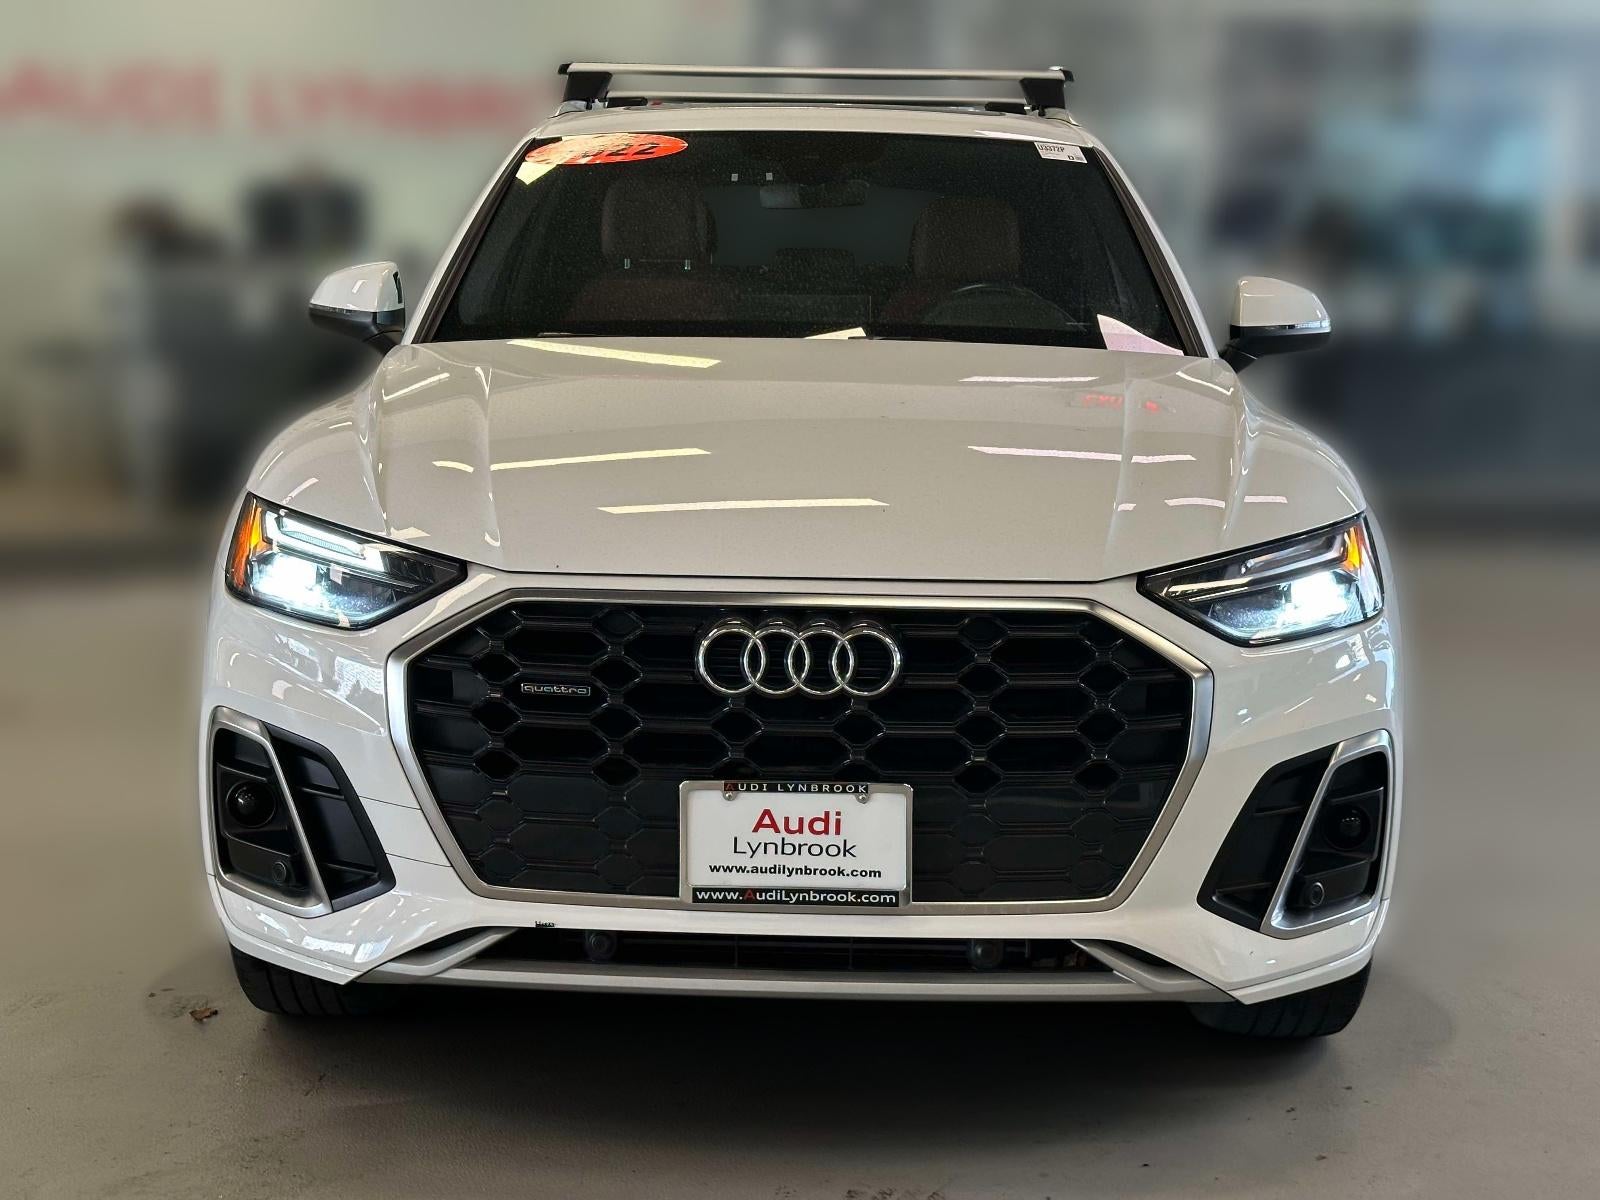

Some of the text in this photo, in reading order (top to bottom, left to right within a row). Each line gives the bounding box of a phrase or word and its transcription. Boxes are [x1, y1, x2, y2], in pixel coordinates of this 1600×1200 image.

[524, 685, 587, 694] quattro
[726, 783, 867, 793] AUDI LYNBROOK
[752, 808, 842, 836] Audi
[733, 836, 857, 859] Lynbrook
[709, 864, 882, 878] www.audilynbrook.com
[696, 889, 896, 904] www.AudiLynbrook.com
